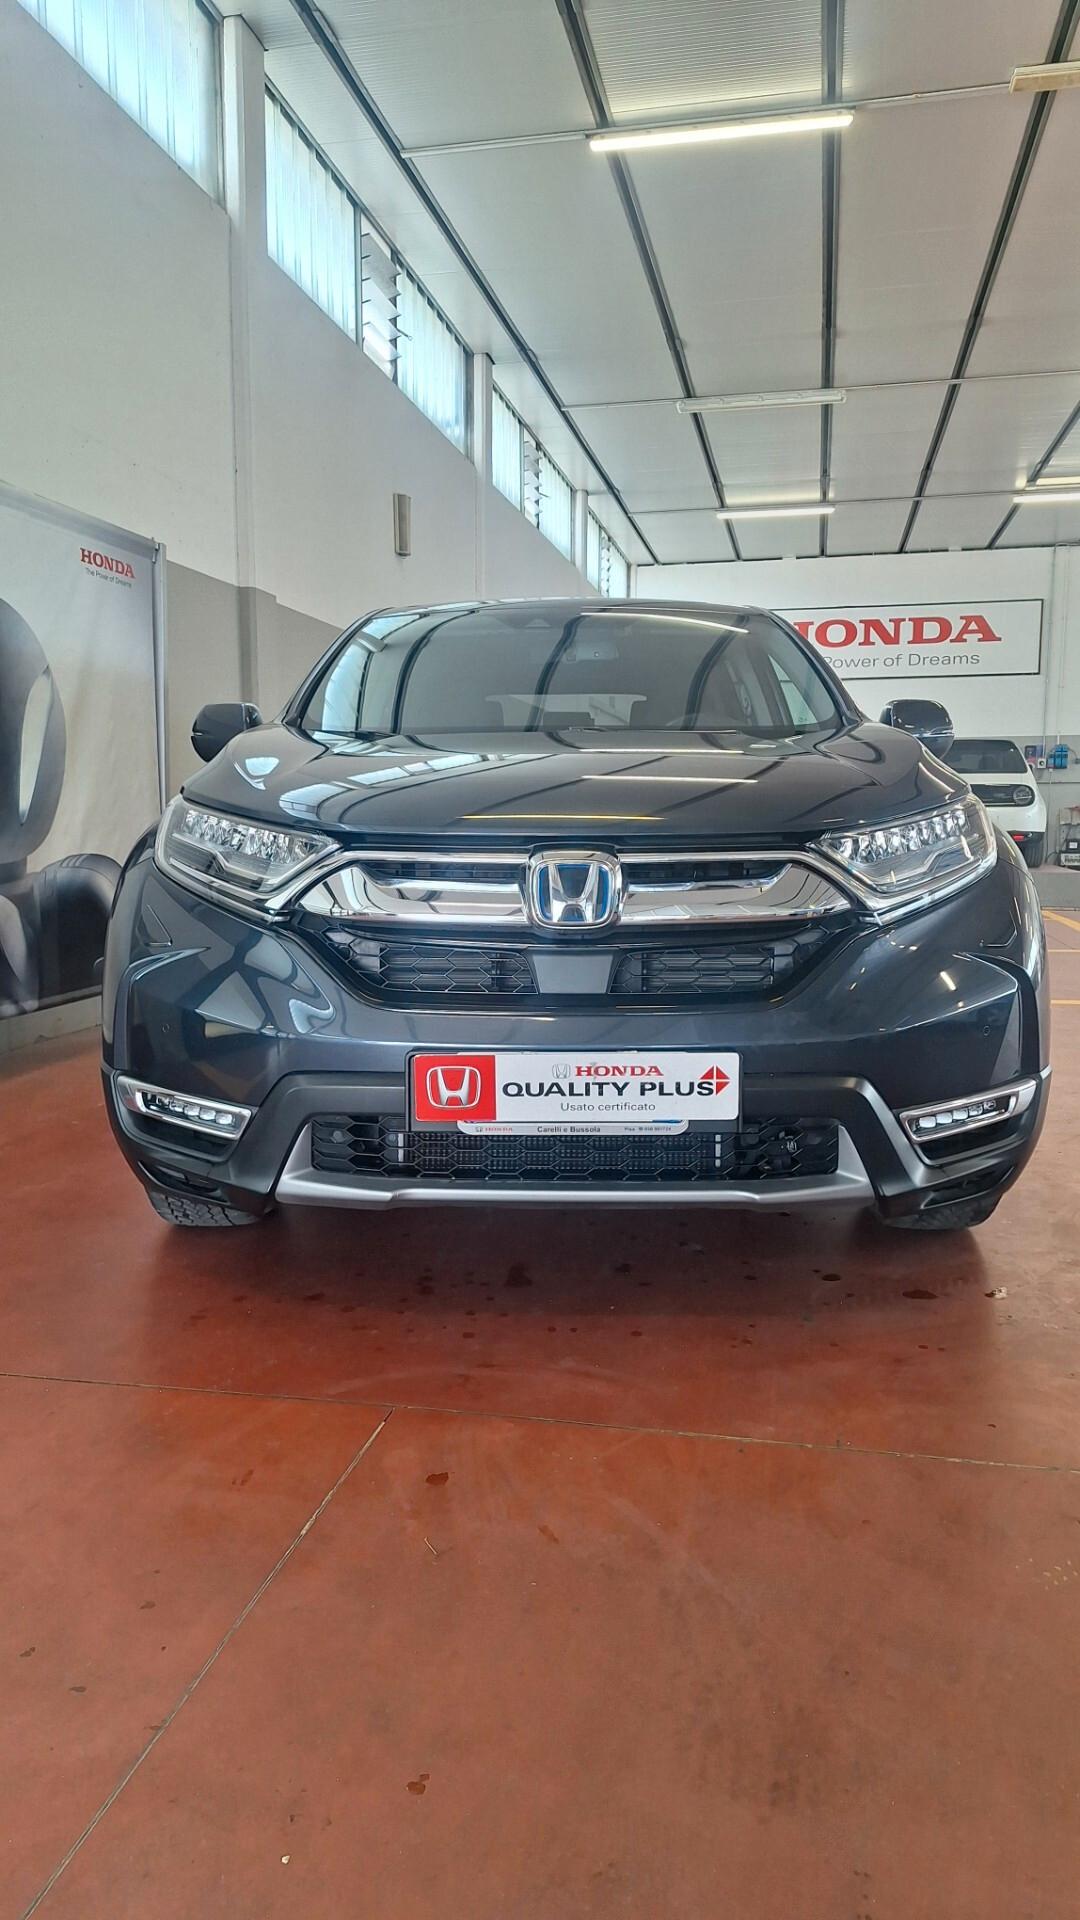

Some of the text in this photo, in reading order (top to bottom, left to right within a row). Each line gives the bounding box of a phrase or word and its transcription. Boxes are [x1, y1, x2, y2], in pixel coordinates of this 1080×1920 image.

[80, 548, 136, 579] HONDA
[86, 567, 95, 576] The
[96, 570, 109, 581] Power
[115, 576, 132, 588] Dreams
[883, 654, 904, 667] of
[908, 652, 980, 667] Dreams
[575, 1065, 664, 1077] HONDA
[502, 1081, 714, 1097] QUALITY PLUS
[560, 1101, 656, 1112] Usato certificato
